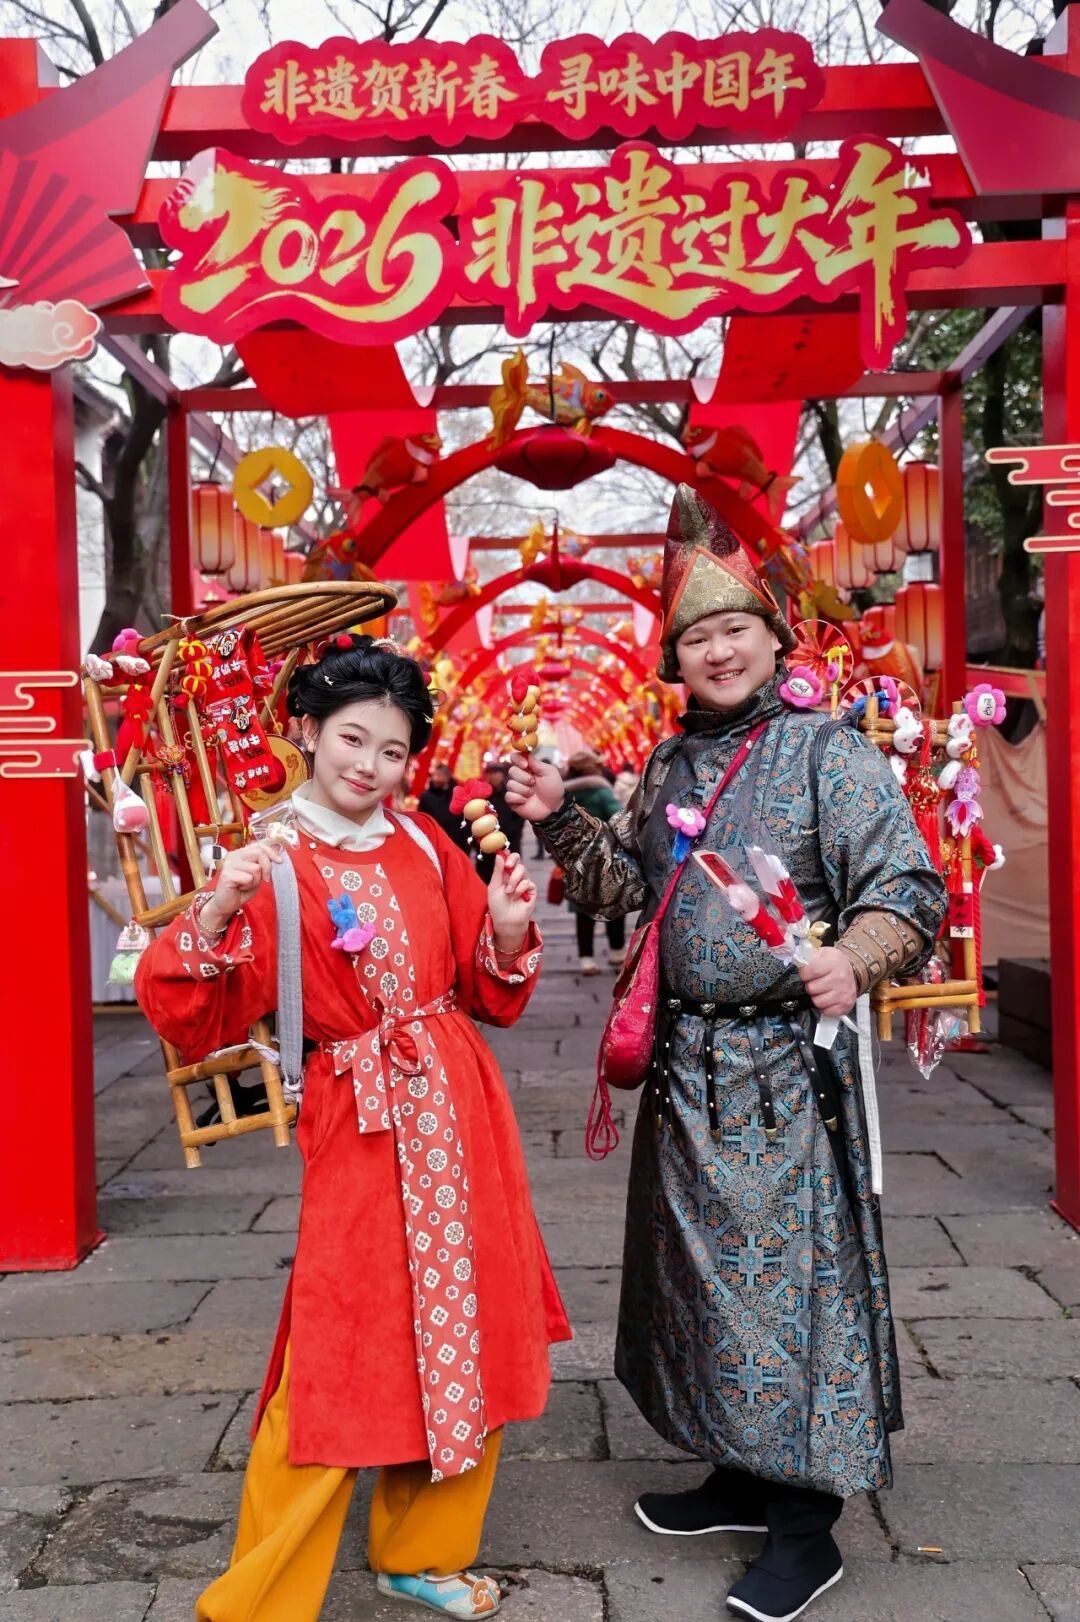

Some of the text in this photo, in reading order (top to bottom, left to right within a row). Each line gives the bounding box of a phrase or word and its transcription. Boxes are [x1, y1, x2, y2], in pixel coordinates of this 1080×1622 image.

[262, 48, 806, 121] 非遗贺新春 寻味中国年
[177, 143, 960, 353] 2026 非遗过大年
